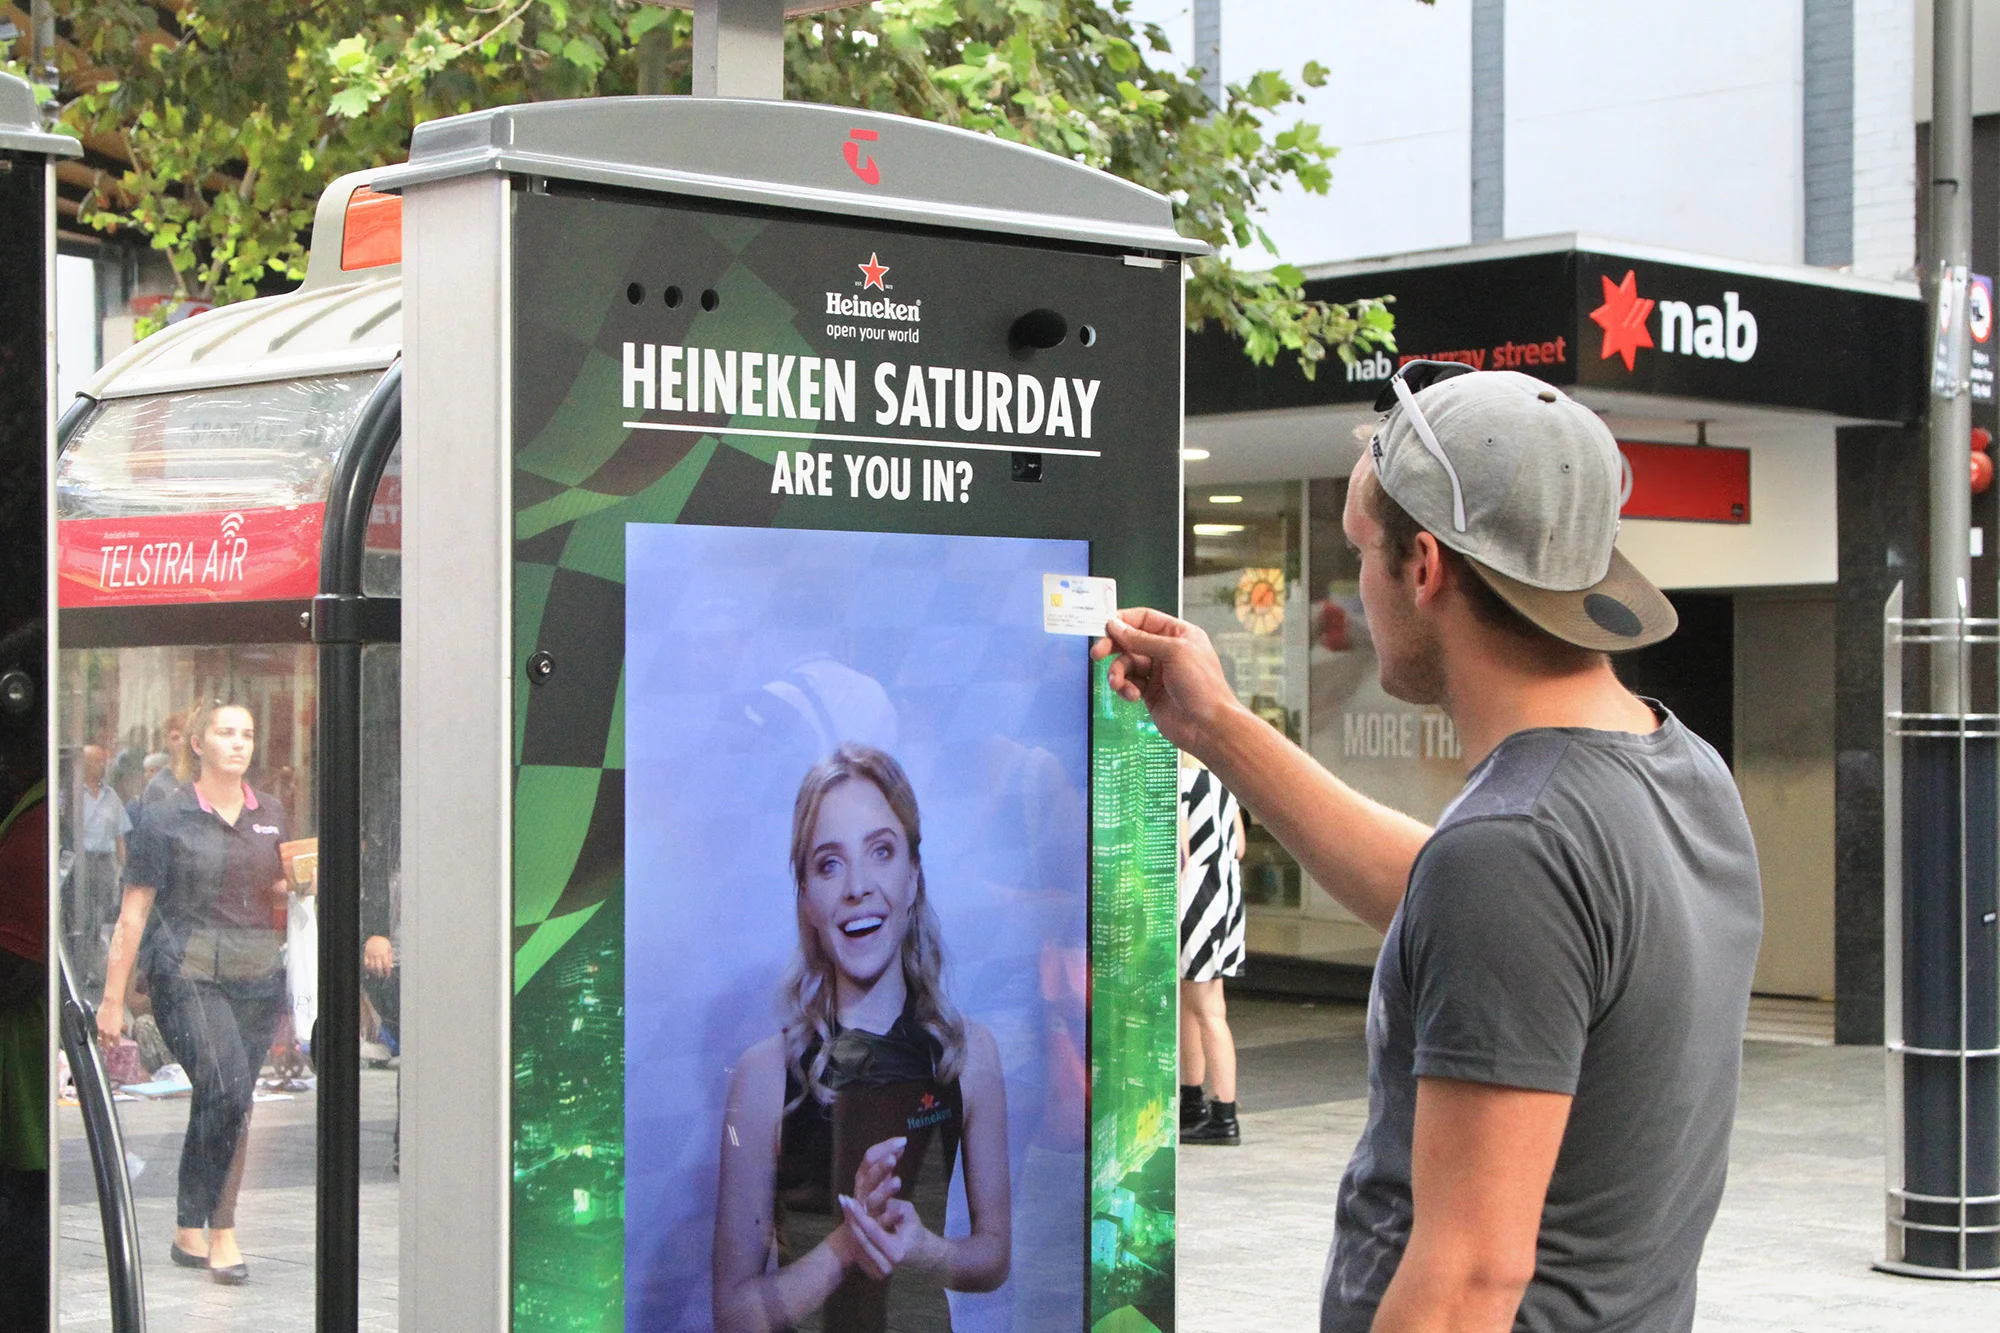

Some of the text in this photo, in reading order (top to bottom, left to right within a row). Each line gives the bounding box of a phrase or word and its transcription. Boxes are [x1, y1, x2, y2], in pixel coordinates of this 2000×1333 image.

[826, 292, 921, 322] Heineken
[1659, 291, 1758, 363] nab
[826, 324, 920, 344] open your world
[1346, 335, 1567, 383] nab rray street
[622, 342, 1101, 439] HEINEKEN SATURDAY
[770, 450, 974, 504] ARE YOU IN?
[100, 541, 195, 588] TELSTRA
[1343, 712, 1413, 757] MORE
